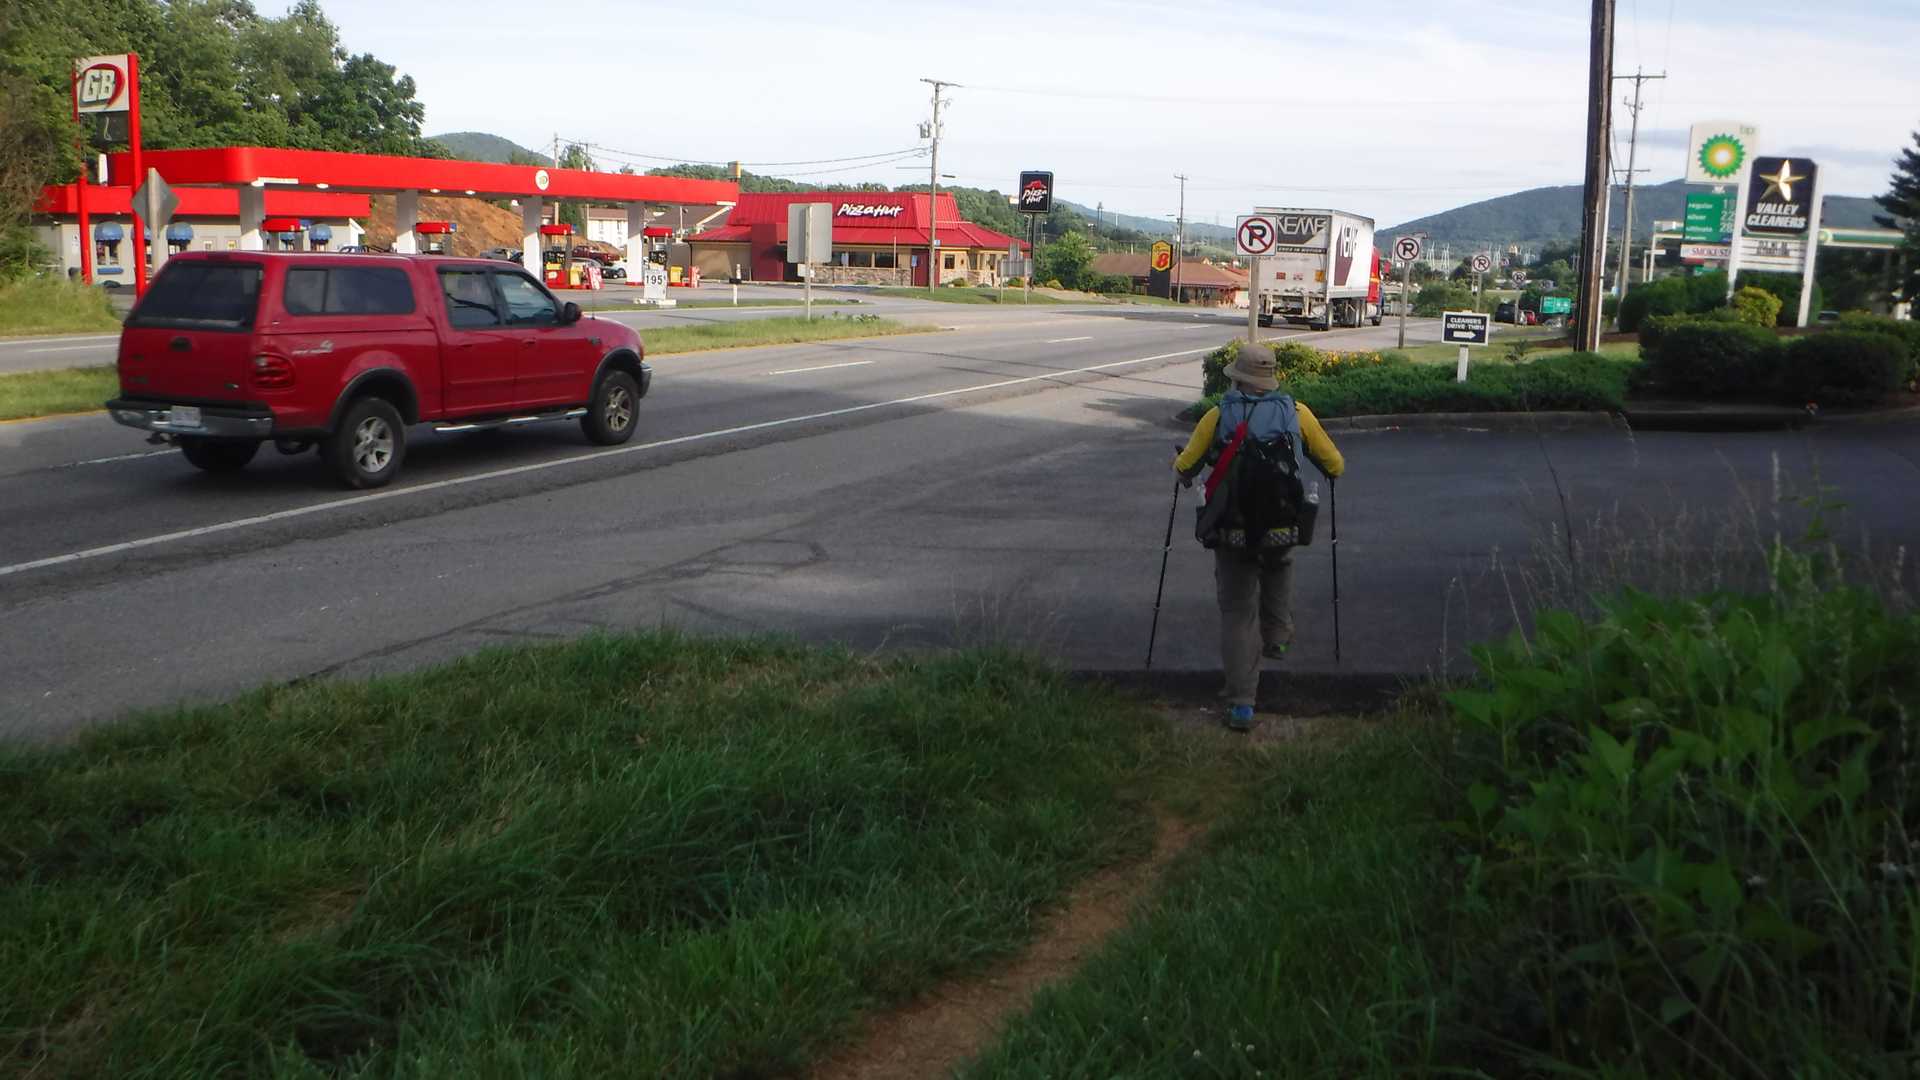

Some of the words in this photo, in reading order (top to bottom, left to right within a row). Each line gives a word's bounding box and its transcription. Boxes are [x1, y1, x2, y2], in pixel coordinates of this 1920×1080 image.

[1756, 202, 1799, 215] VALLEY
[1747, 214, 1807, 229] CLEANERS
[1156, 252, 1169, 268] 8
